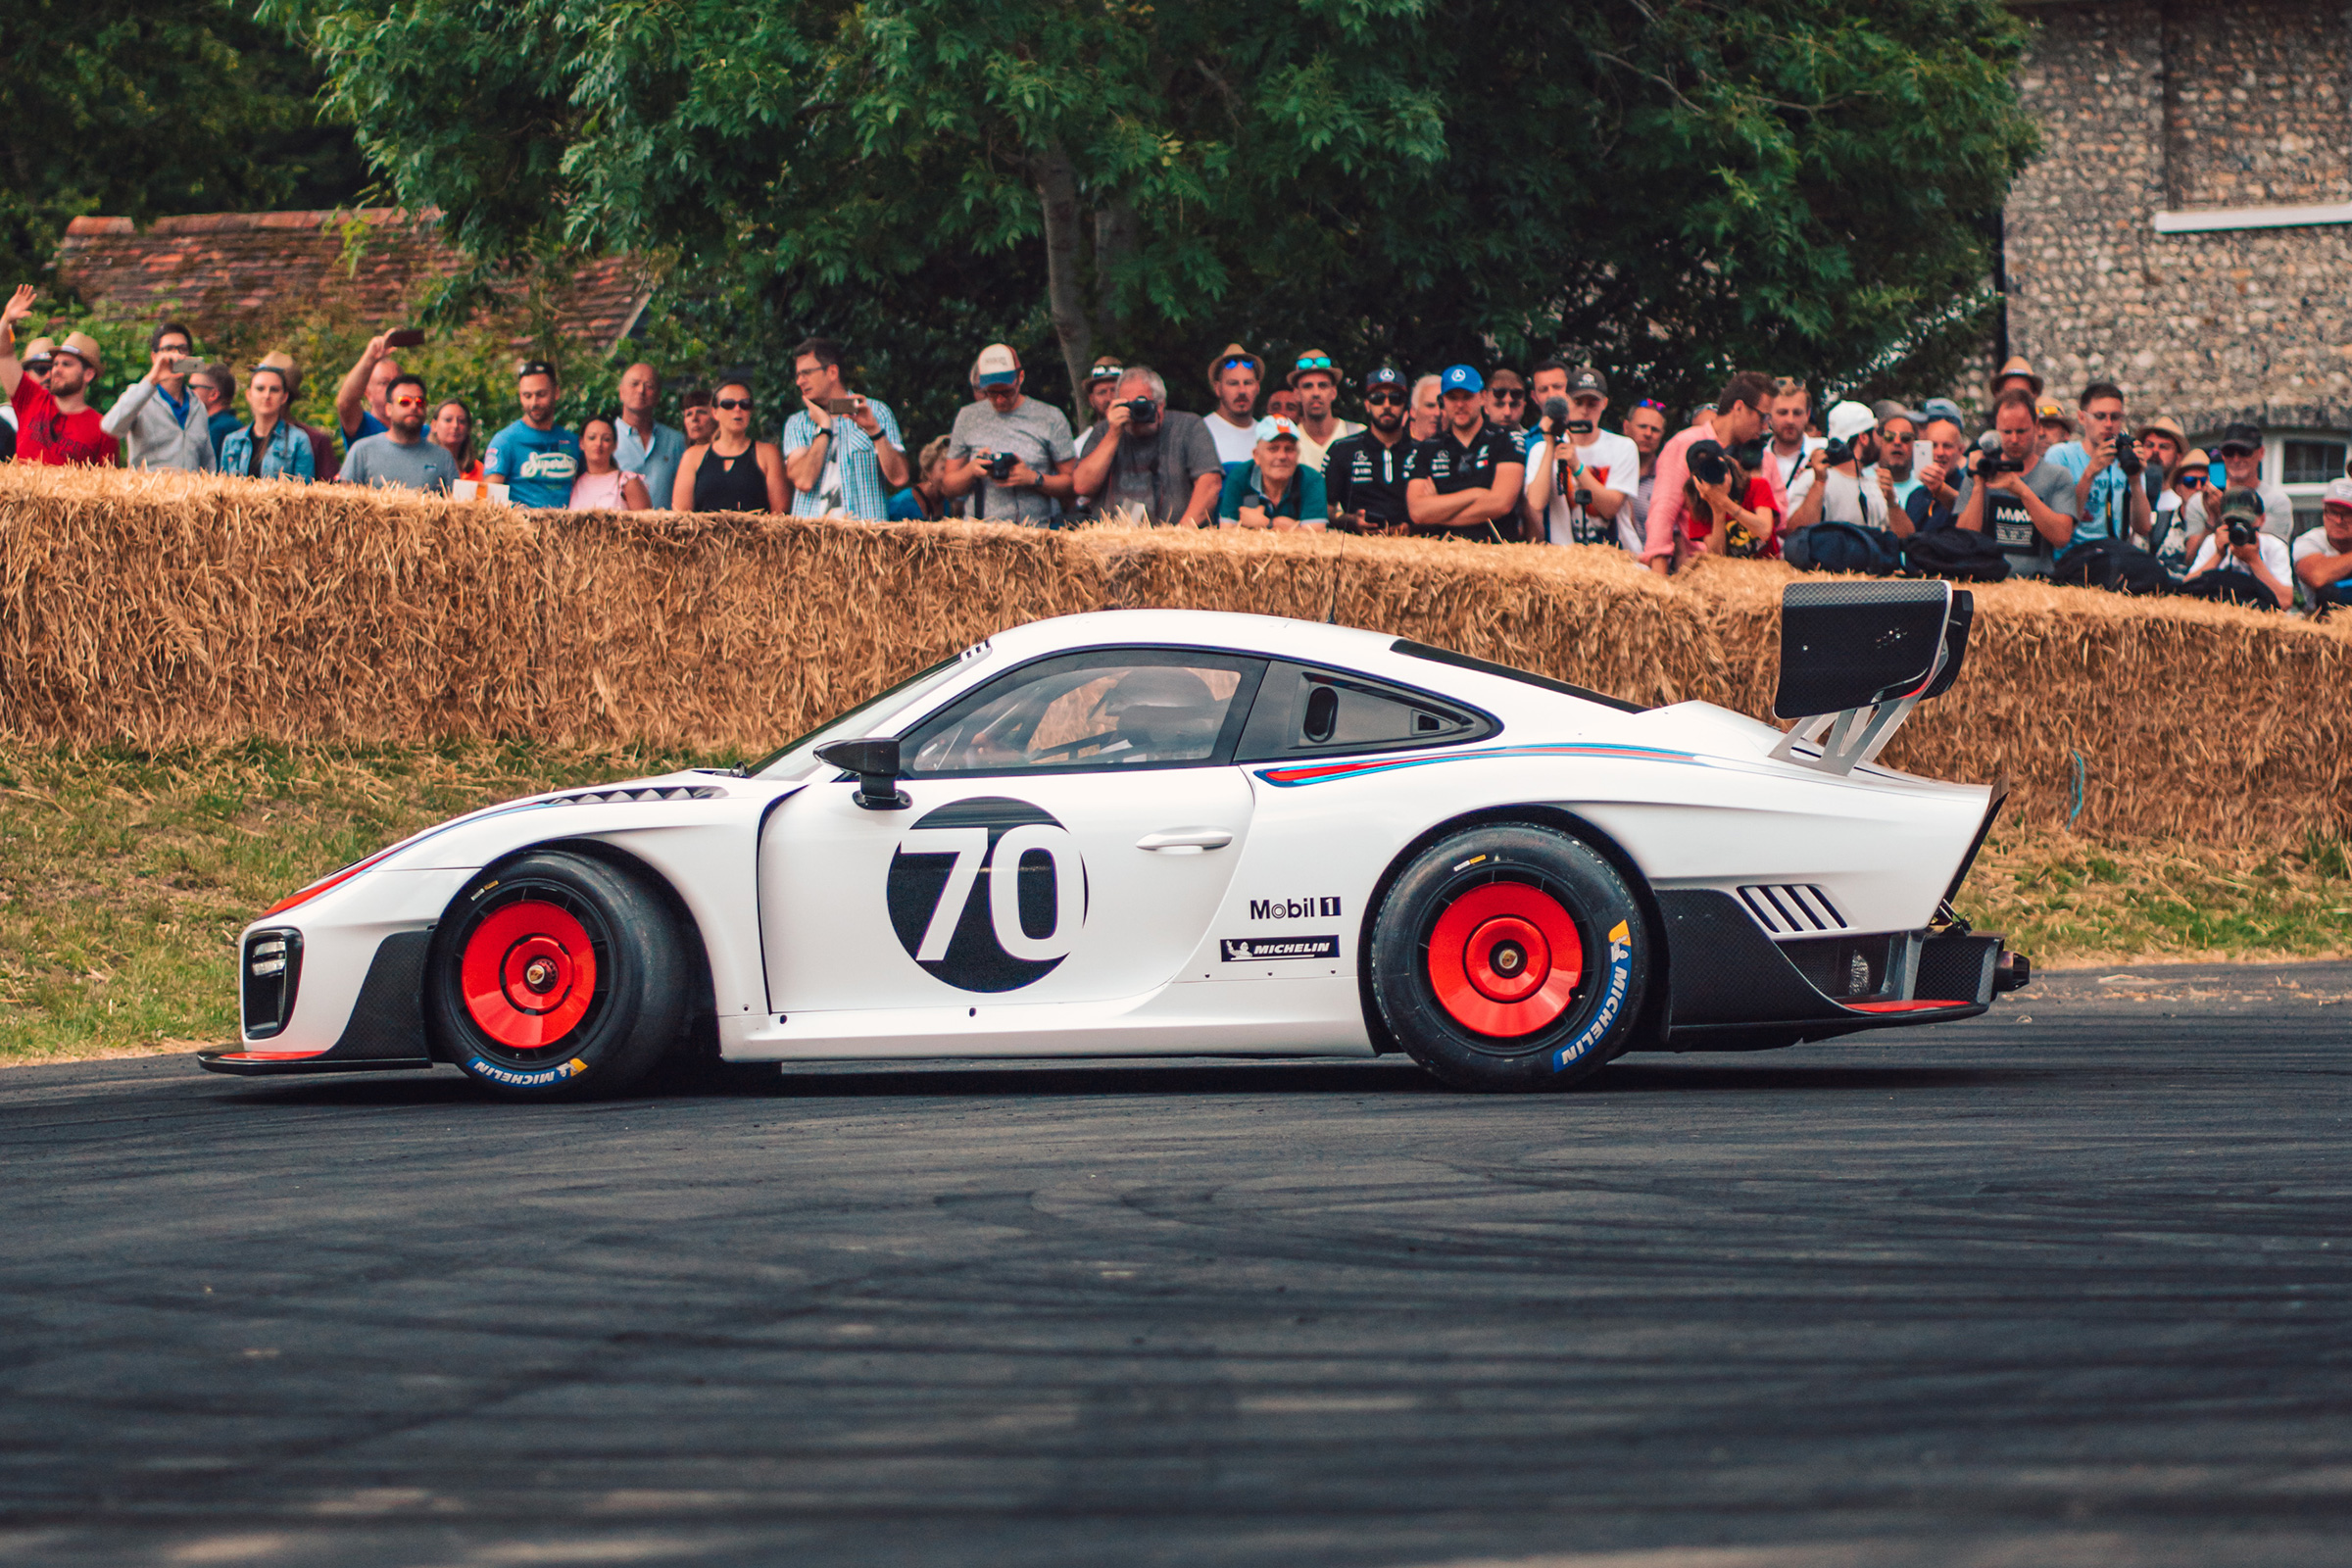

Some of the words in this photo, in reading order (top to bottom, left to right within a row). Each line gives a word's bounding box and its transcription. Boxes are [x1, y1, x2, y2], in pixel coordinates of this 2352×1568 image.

[901, 823, 1083, 961] 70
[1250, 897, 1315, 920] Mobil
[1323, 897, 1337, 916] 1
[1253, 942, 1331, 956] MICHELIN
[1561, 965, 1628, 1066] MICHELIN
[473, 1060, 556, 1085] MICHELIN
